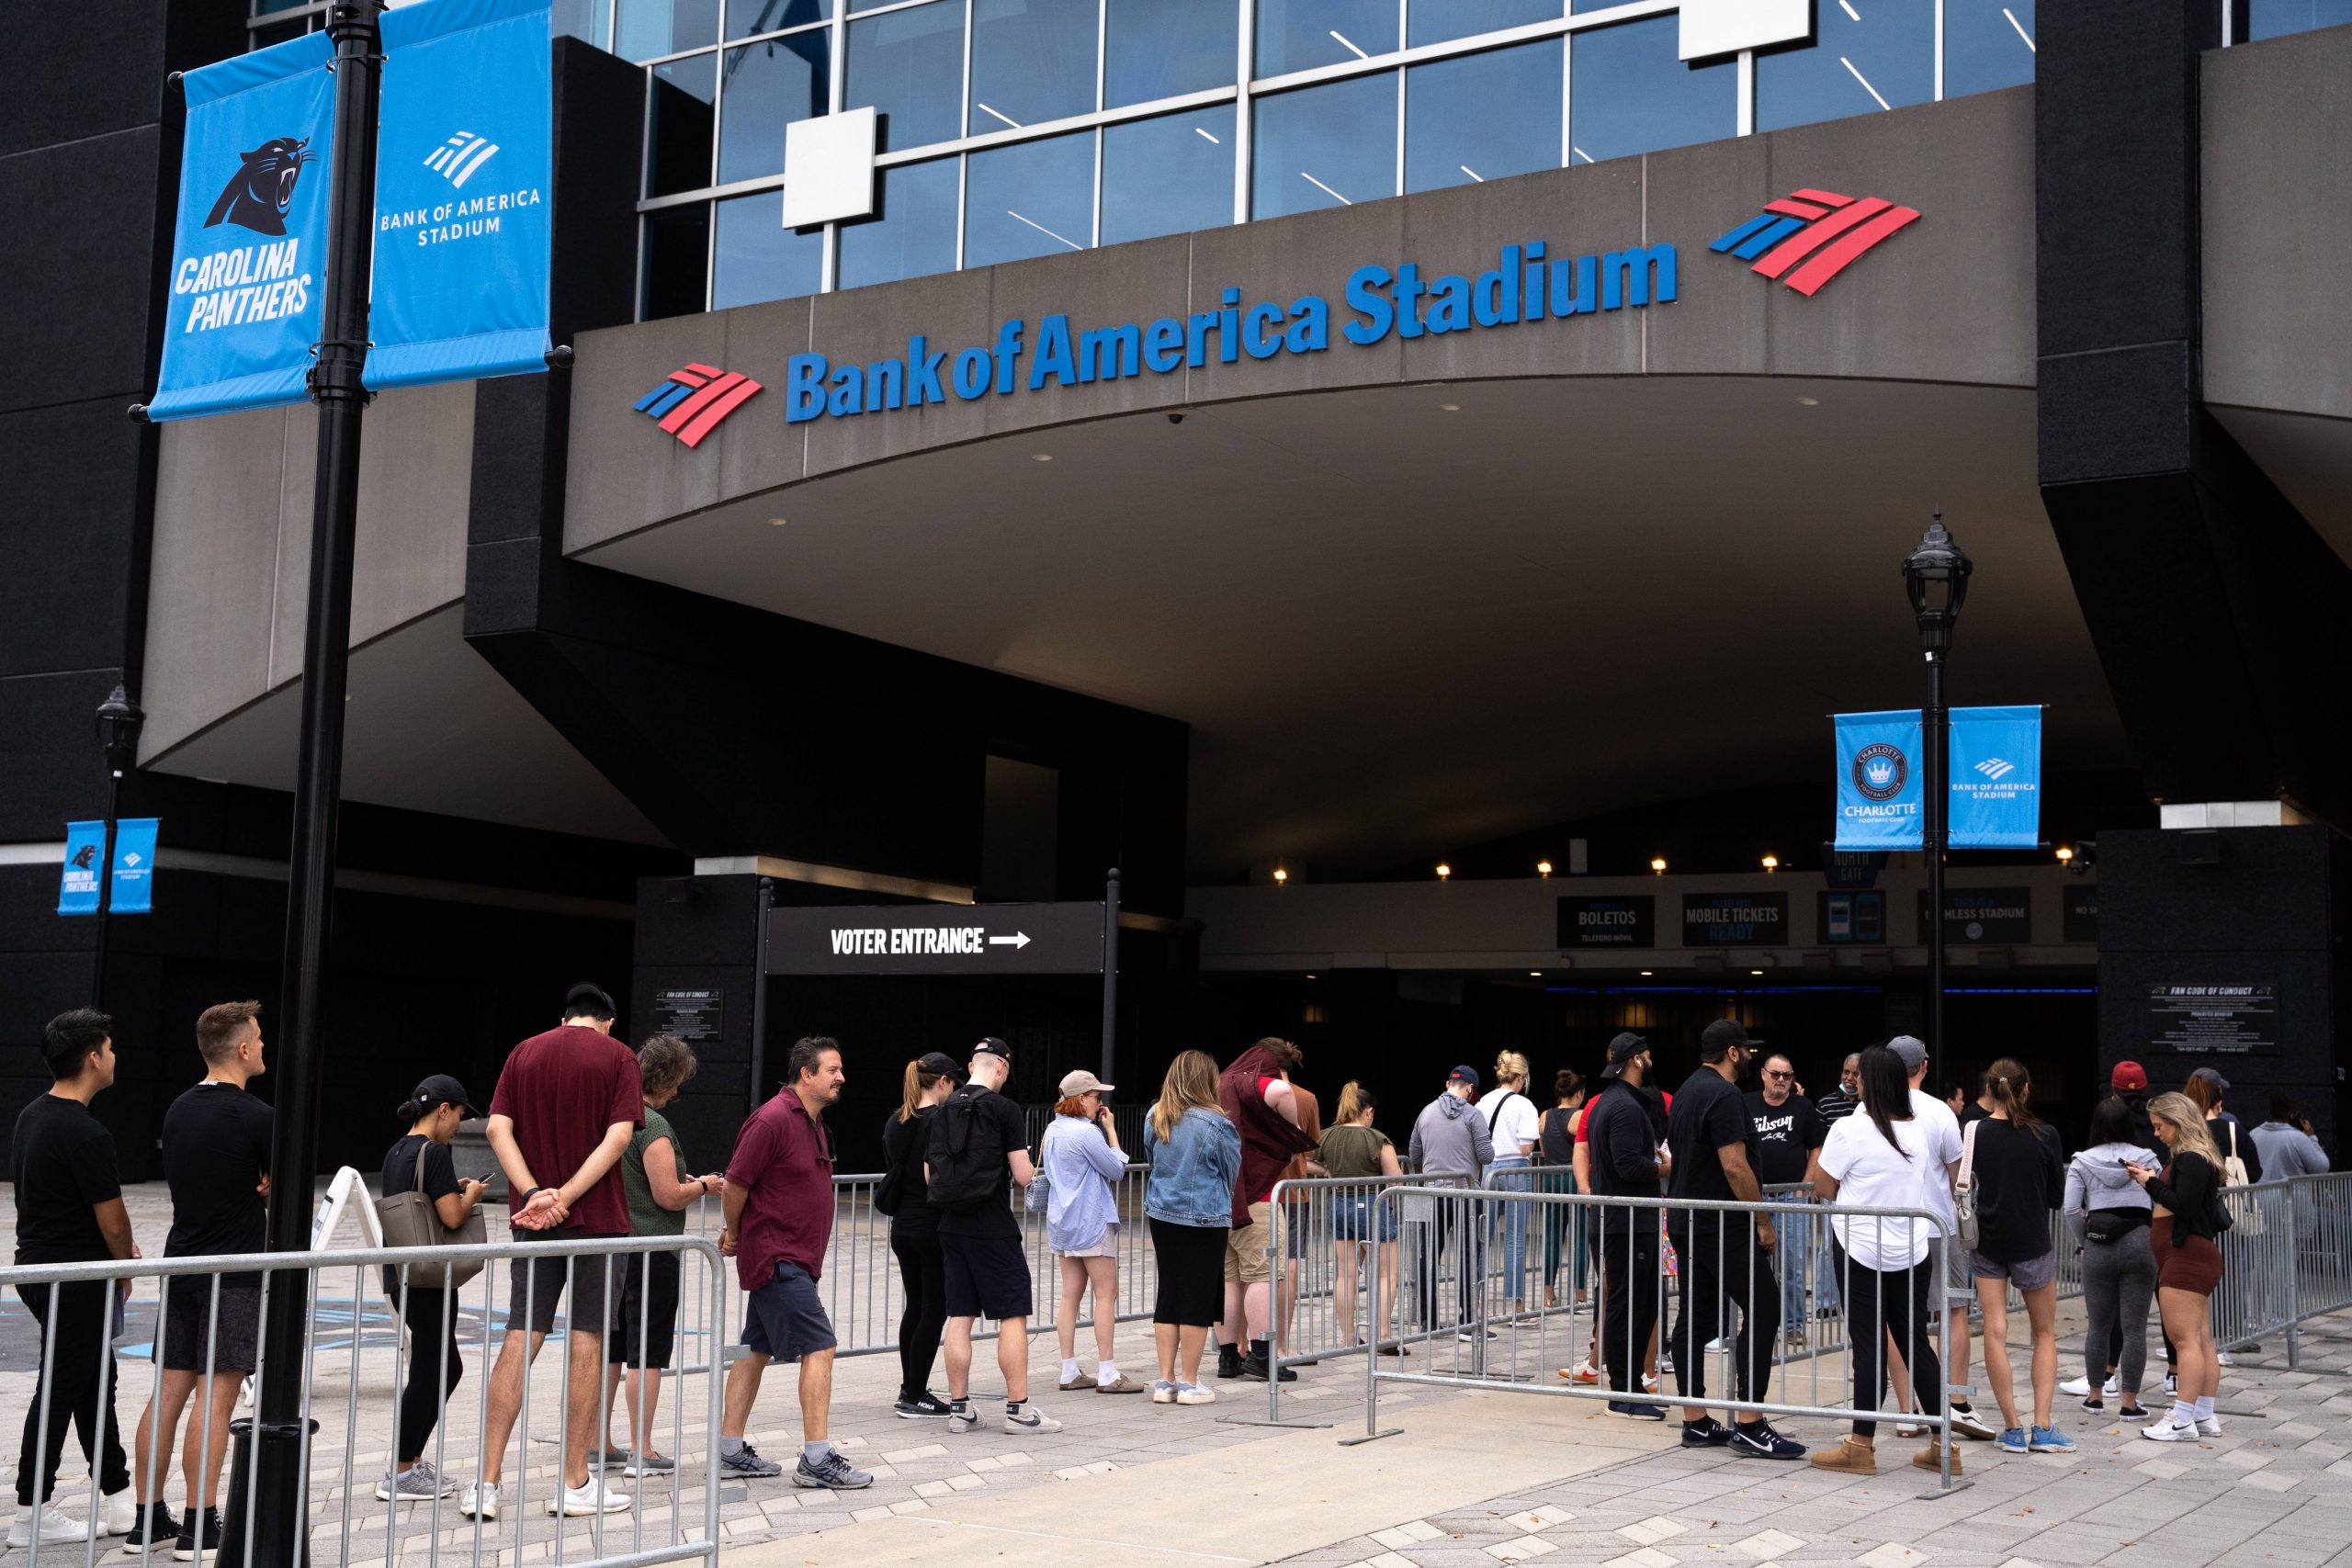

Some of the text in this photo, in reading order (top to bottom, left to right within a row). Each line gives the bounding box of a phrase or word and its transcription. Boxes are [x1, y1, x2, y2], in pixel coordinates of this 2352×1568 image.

[380, 188, 540, 231] BANK OF AMERICA
[418, 217, 500, 246] STADIUM
[175, 237, 299, 295] CAROLINA
[185, 274, 311, 333] PANTHERS
[786, 241, 1678, 423] Bank of America Stadium
[1858, 746, 1901, 763] CHARLOTTE
[1860, 783, 1901, 797] FOOTBALL CLUB
[1845, 803, 1917, 817] CHARLOTTE
[1840, 867, 1863, 882] GATE
[1578, 910, 1636, 926] BOLETOS
[1686, 907, 1779, 923] MOBILE TICKETS
[1925, 907, 2025, 920] HLESS STADIUM
[1709, 923, 1755, 942] READY
[831, 927, 985, 955] VOTER ENTRANCE
[2170, 987, 2253, 996] FAN CODE OF CONDUCT
[917, 1402, 935, 1411] HOKA
